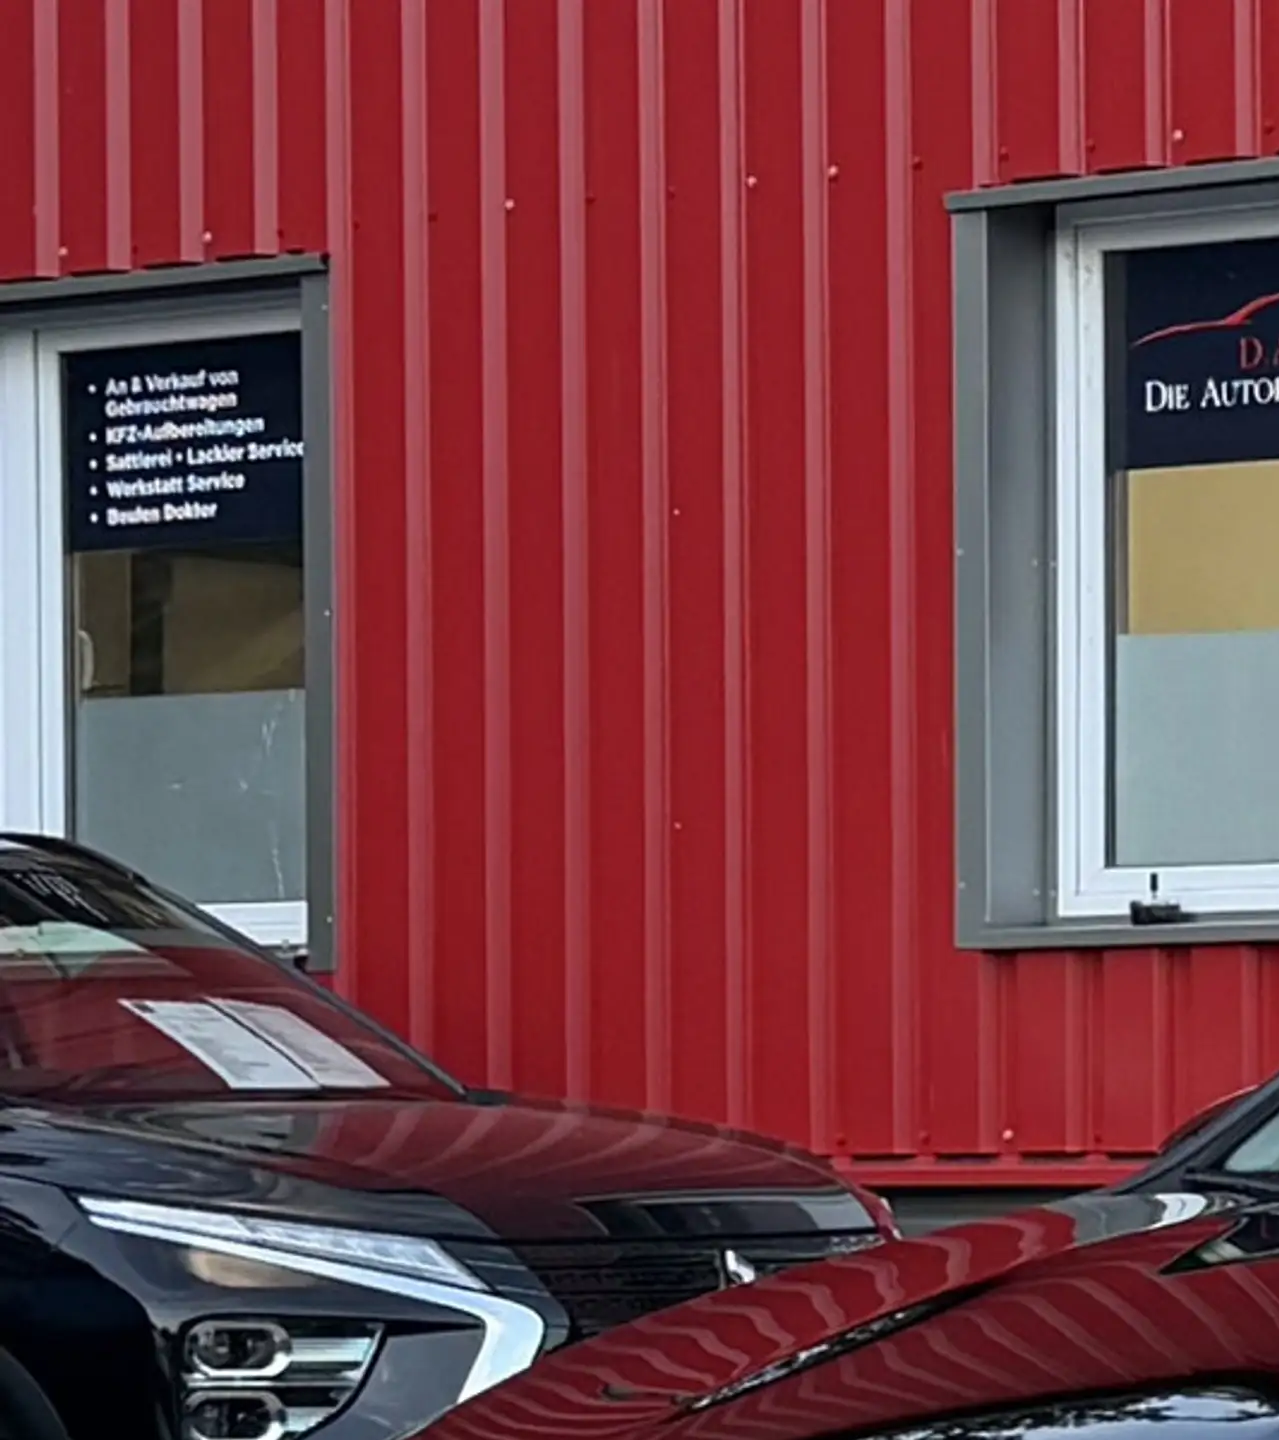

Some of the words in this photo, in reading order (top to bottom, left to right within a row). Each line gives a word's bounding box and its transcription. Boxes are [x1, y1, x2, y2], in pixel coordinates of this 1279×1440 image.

[106, 379, 129, 396] An
[131, 376, 141, 393] &
[146, 370, 206, 391] Verkauf
[209, 370, 239, 387] von
[105, 392, 237, 417] Gebrauchtwagen
[106, 417, 265, 444] KFZ-Aufbereitungen
[106, 450, 173, 472] Sattlerei
[187, 444, 244, 465] Lackier
[106, 477, 183, 498] Werkstatt
[188, 472, 244, 493] Service
[107, 507, 159, 526] Beulen
[164, 503, 217, 522] Doktor
